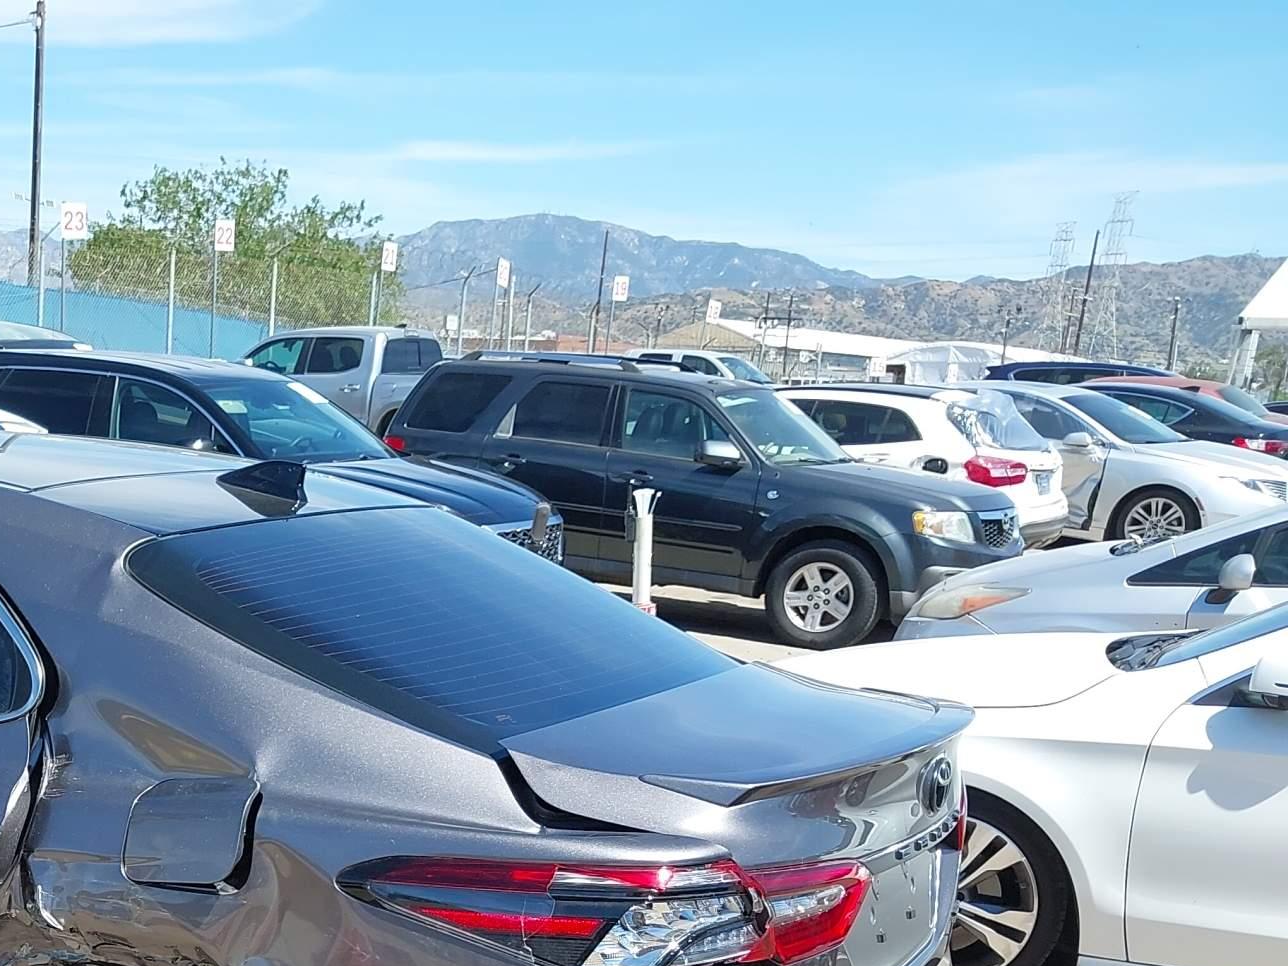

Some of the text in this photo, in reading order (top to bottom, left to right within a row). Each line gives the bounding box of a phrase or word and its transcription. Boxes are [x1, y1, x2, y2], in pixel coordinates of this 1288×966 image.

[64, 210, 84, 231] 23
[216, 226, 233, 245] 22
[383, 247, 395, 266] 21
